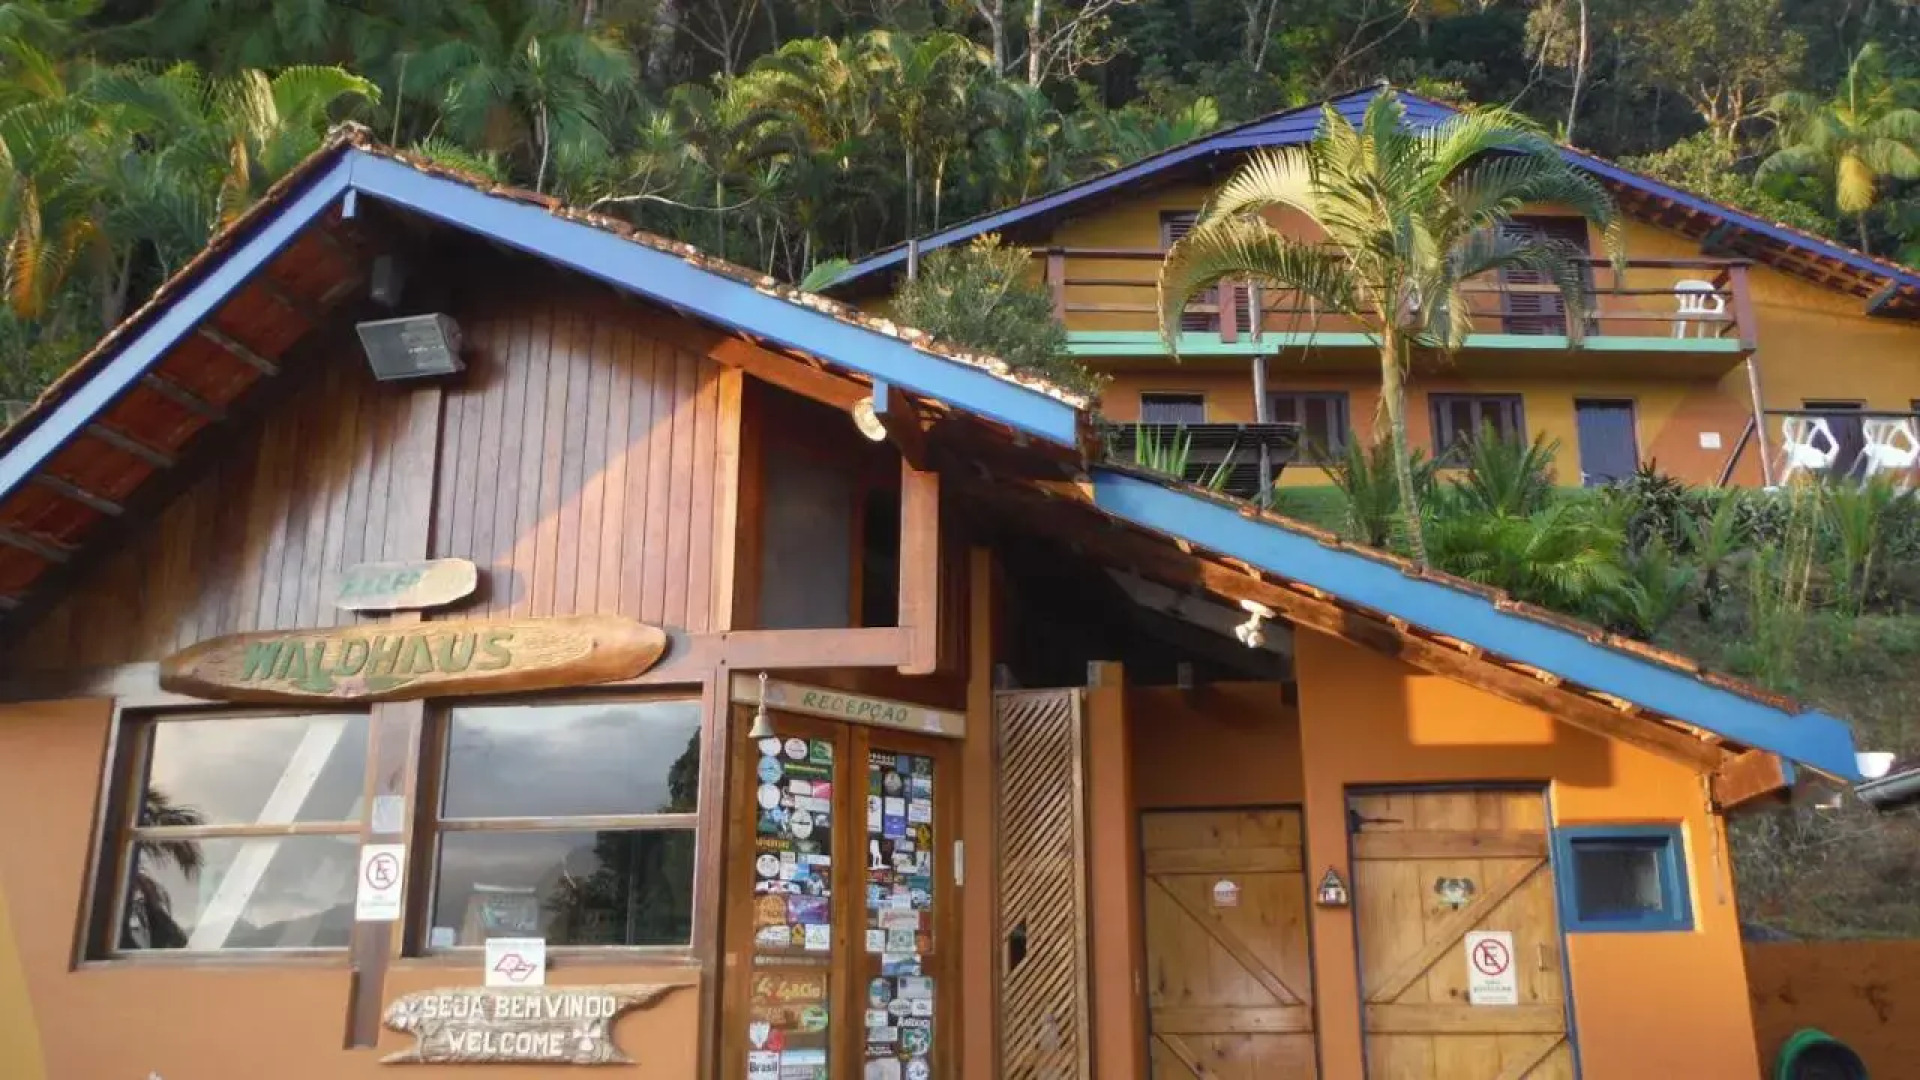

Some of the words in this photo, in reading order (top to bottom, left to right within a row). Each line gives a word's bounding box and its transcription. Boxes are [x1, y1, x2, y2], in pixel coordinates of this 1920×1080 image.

[240, 632, 514, 682] WALDHAUS
[422, 995, 484, 1019] SEJA
[494, 995, 541, 1019] BEM
[545, 994, 617, 1018] VINDO
[449, 1030, 566, 1058] WELCOME
